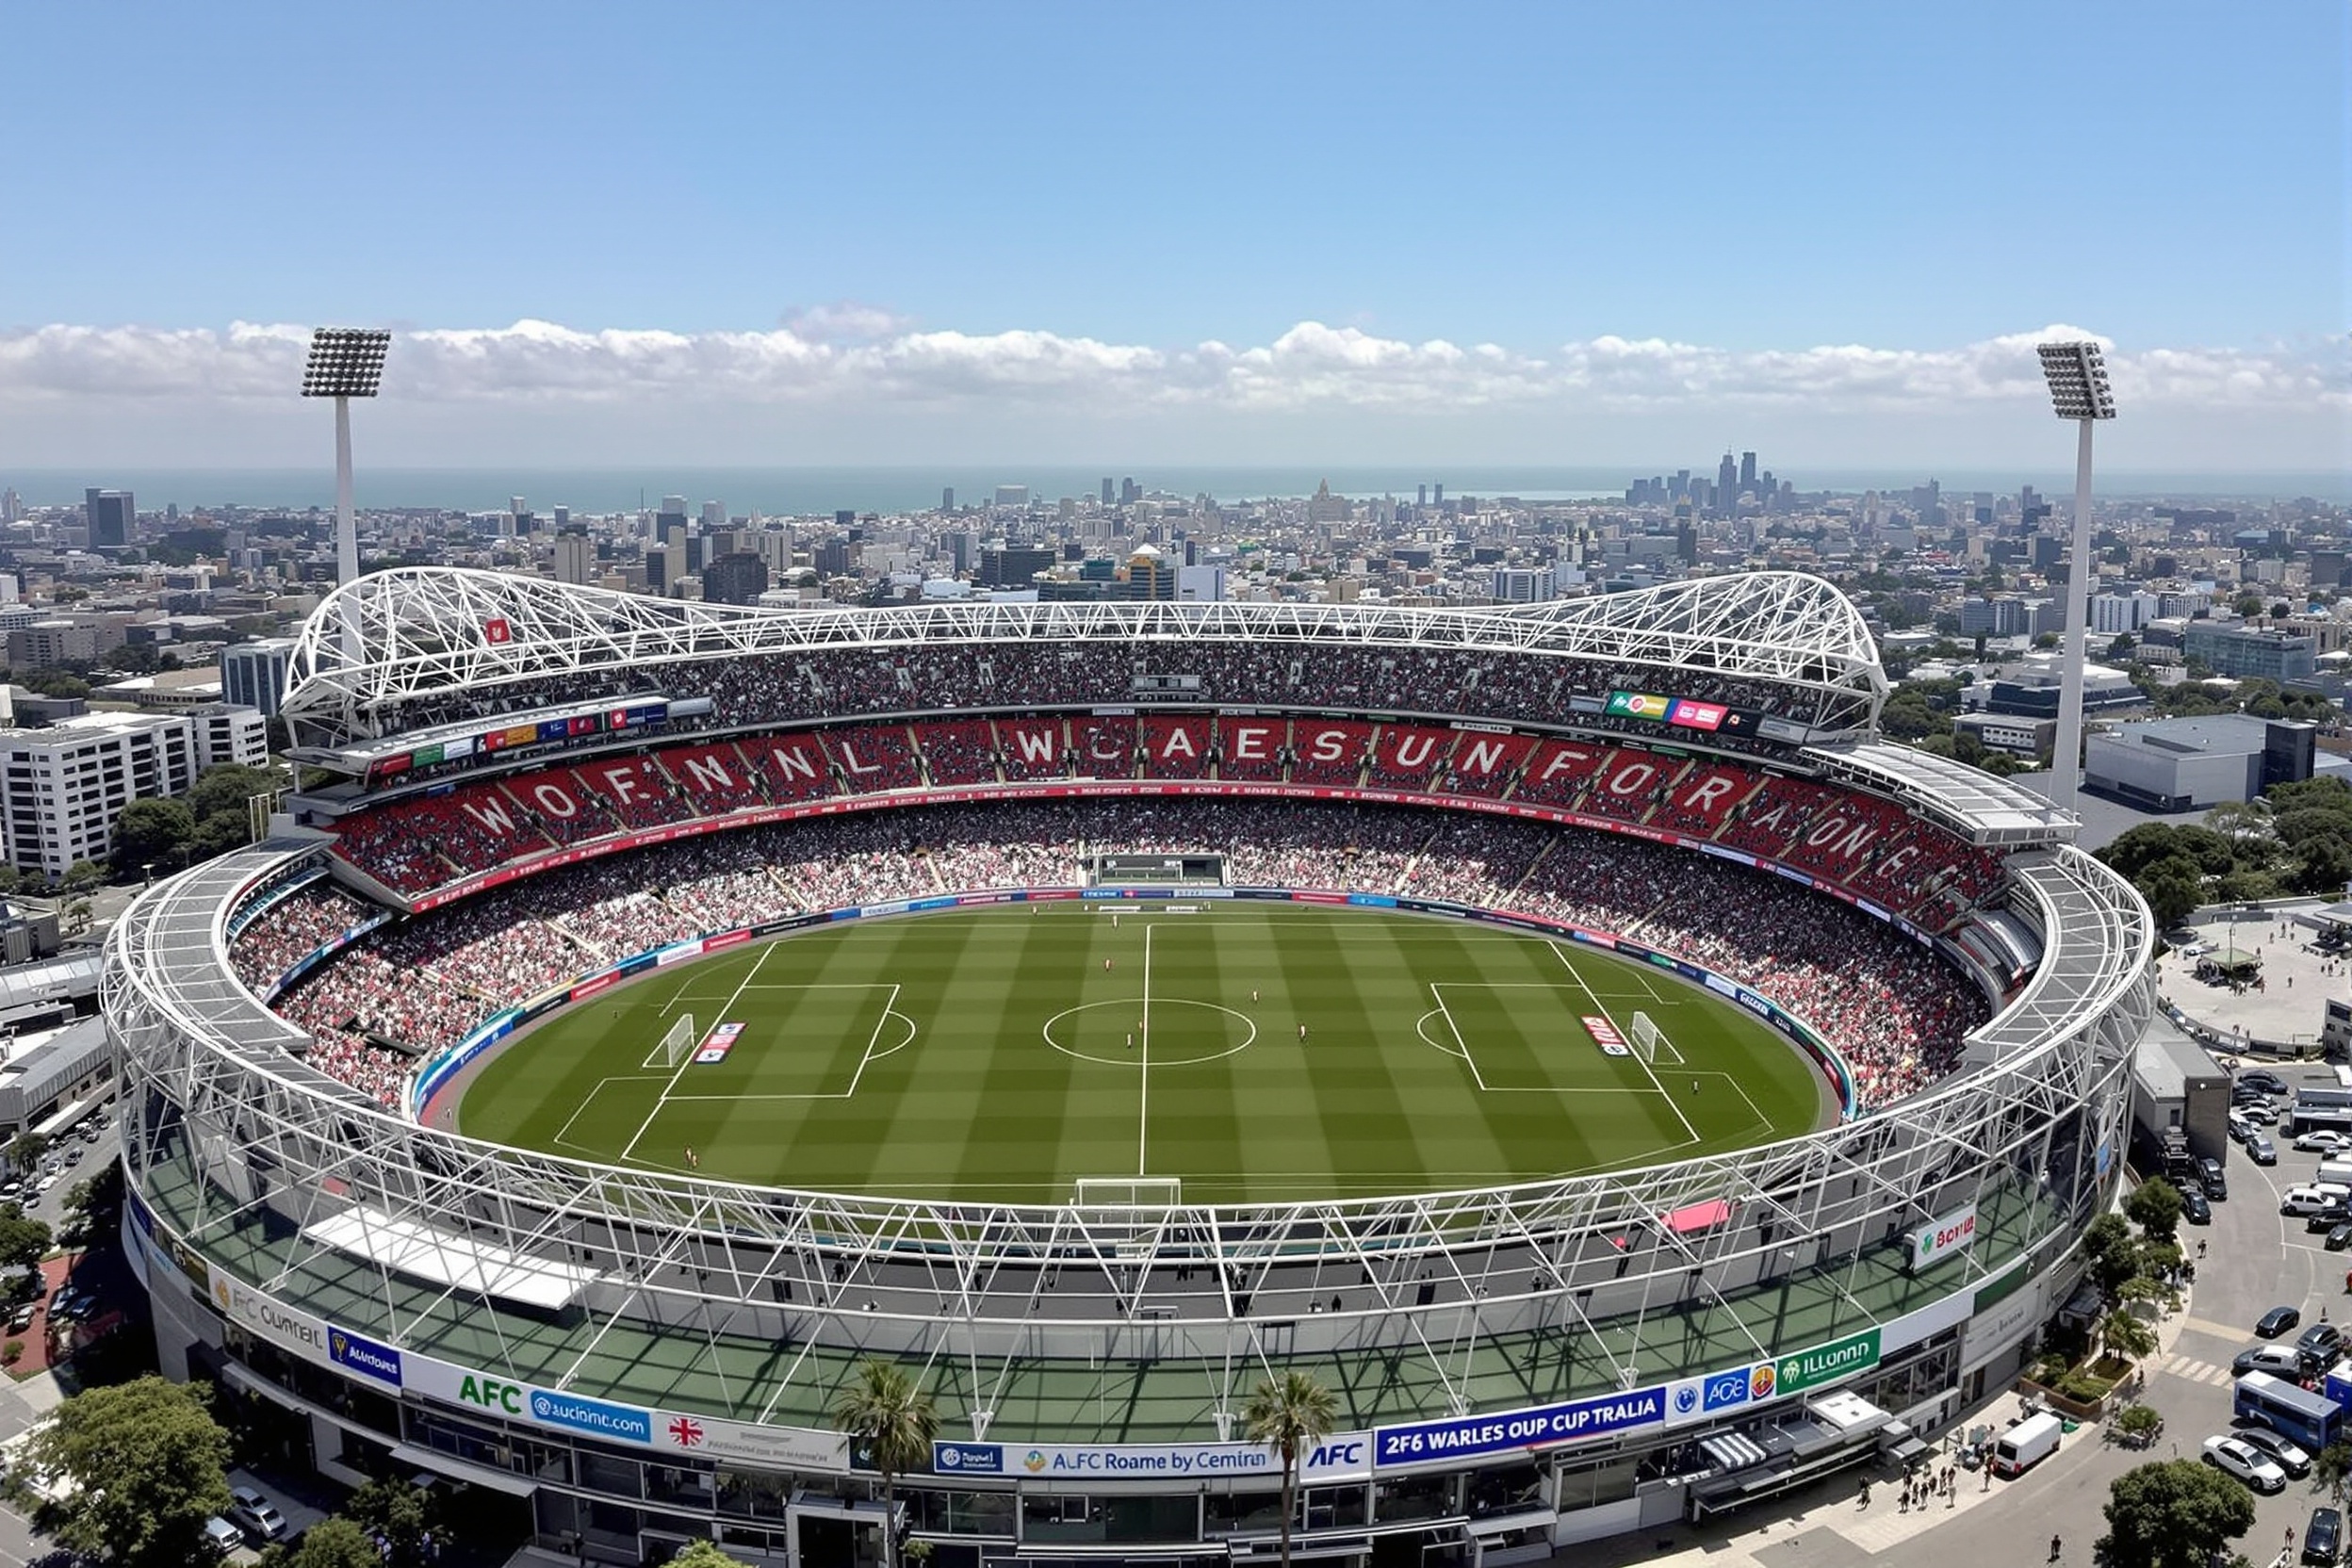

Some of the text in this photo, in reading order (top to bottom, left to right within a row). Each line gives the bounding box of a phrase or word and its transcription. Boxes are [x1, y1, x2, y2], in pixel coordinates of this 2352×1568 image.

[459, 1375, 522, 1414] AFC
[1385, 1397, 1657, 1456] 2F6 WARLES OUP CUP TRALIA
[1104, 1451, 1167, 1470] Roame
[1171, 1450, 1194, 1473] by
[1307, 1442, 1364, 1468] AFC
